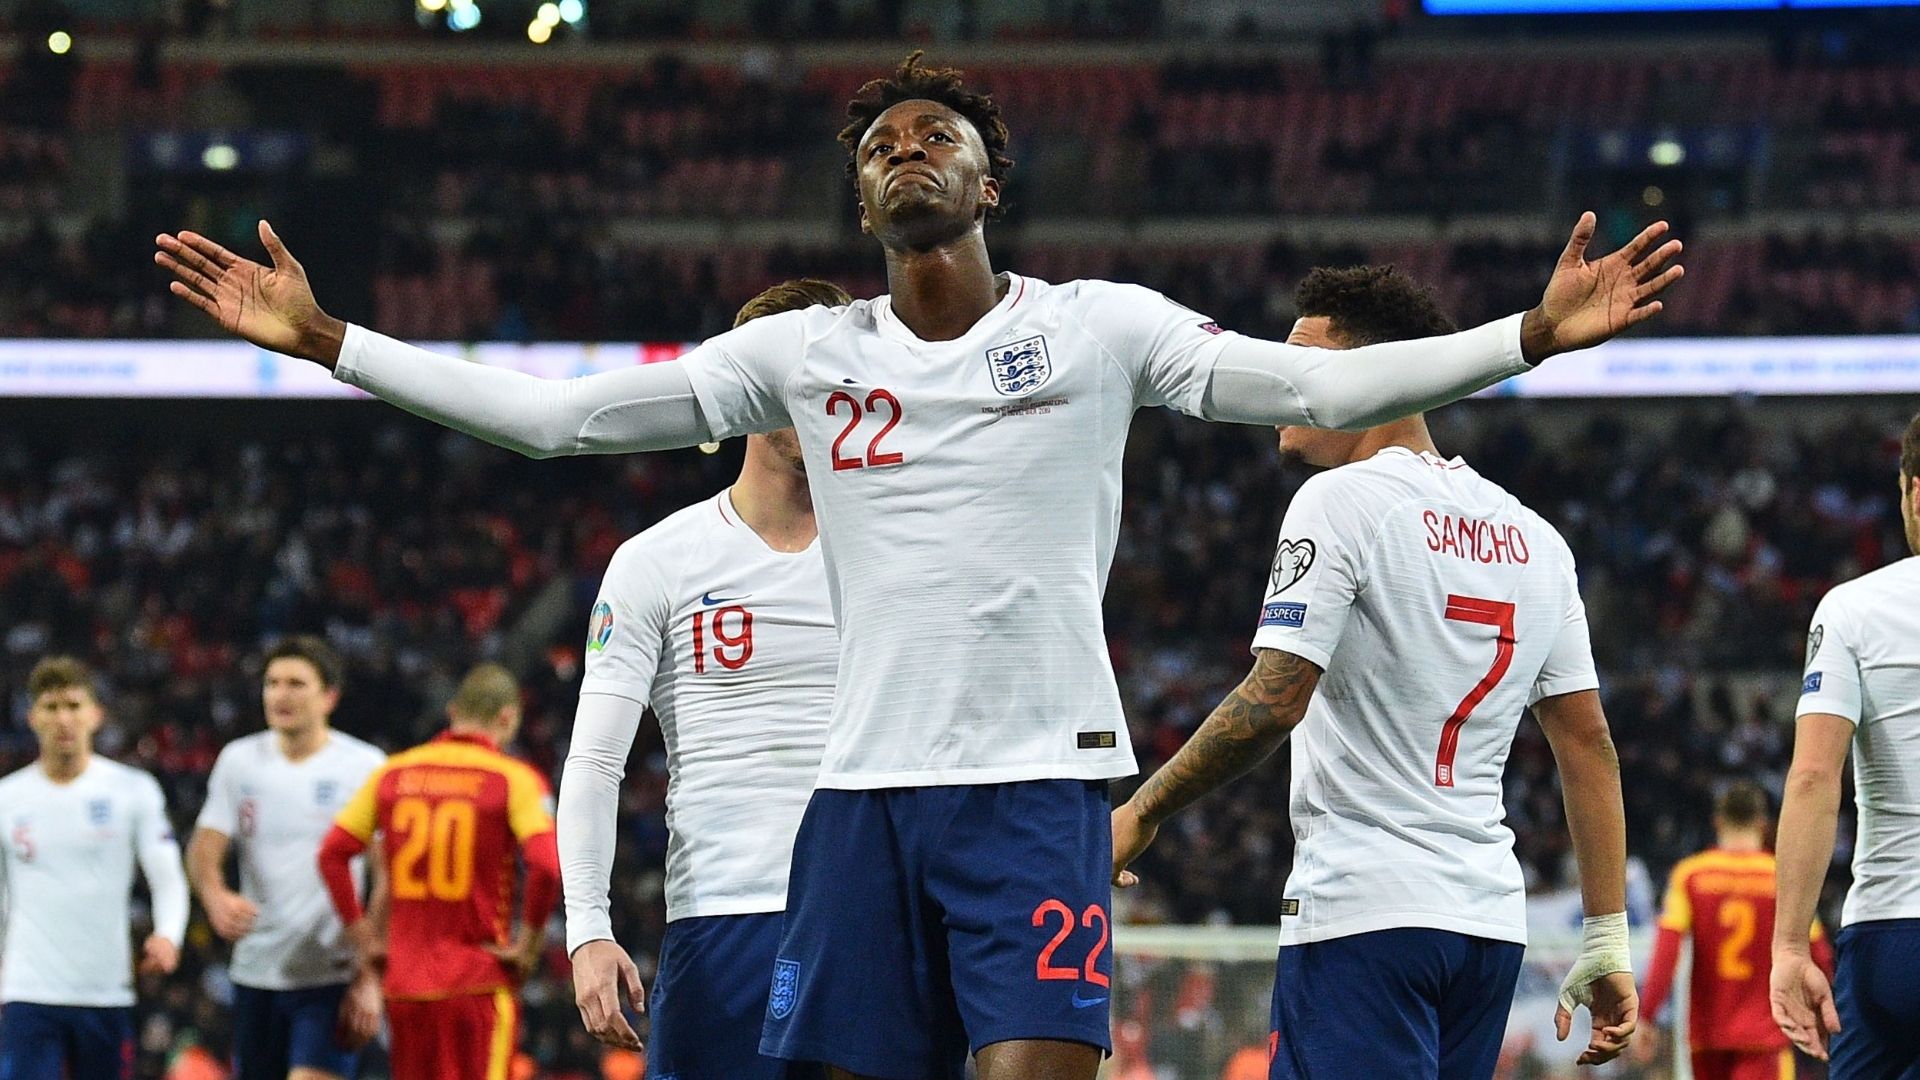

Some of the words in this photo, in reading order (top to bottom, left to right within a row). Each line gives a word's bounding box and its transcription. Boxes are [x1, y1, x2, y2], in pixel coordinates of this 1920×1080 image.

[825, 388, 904, 472] 22
[1423, 510, 1529, 565] SANCHO
[692, 605, 754, 675] 19
[1434, 594, 1516, 788] 7
[12, 825, 36, 864] 5
[391, 796, 477, 901] 20
[1031, 898, 1109, 989] 22
[1718, 898, 1757, 981] 2
